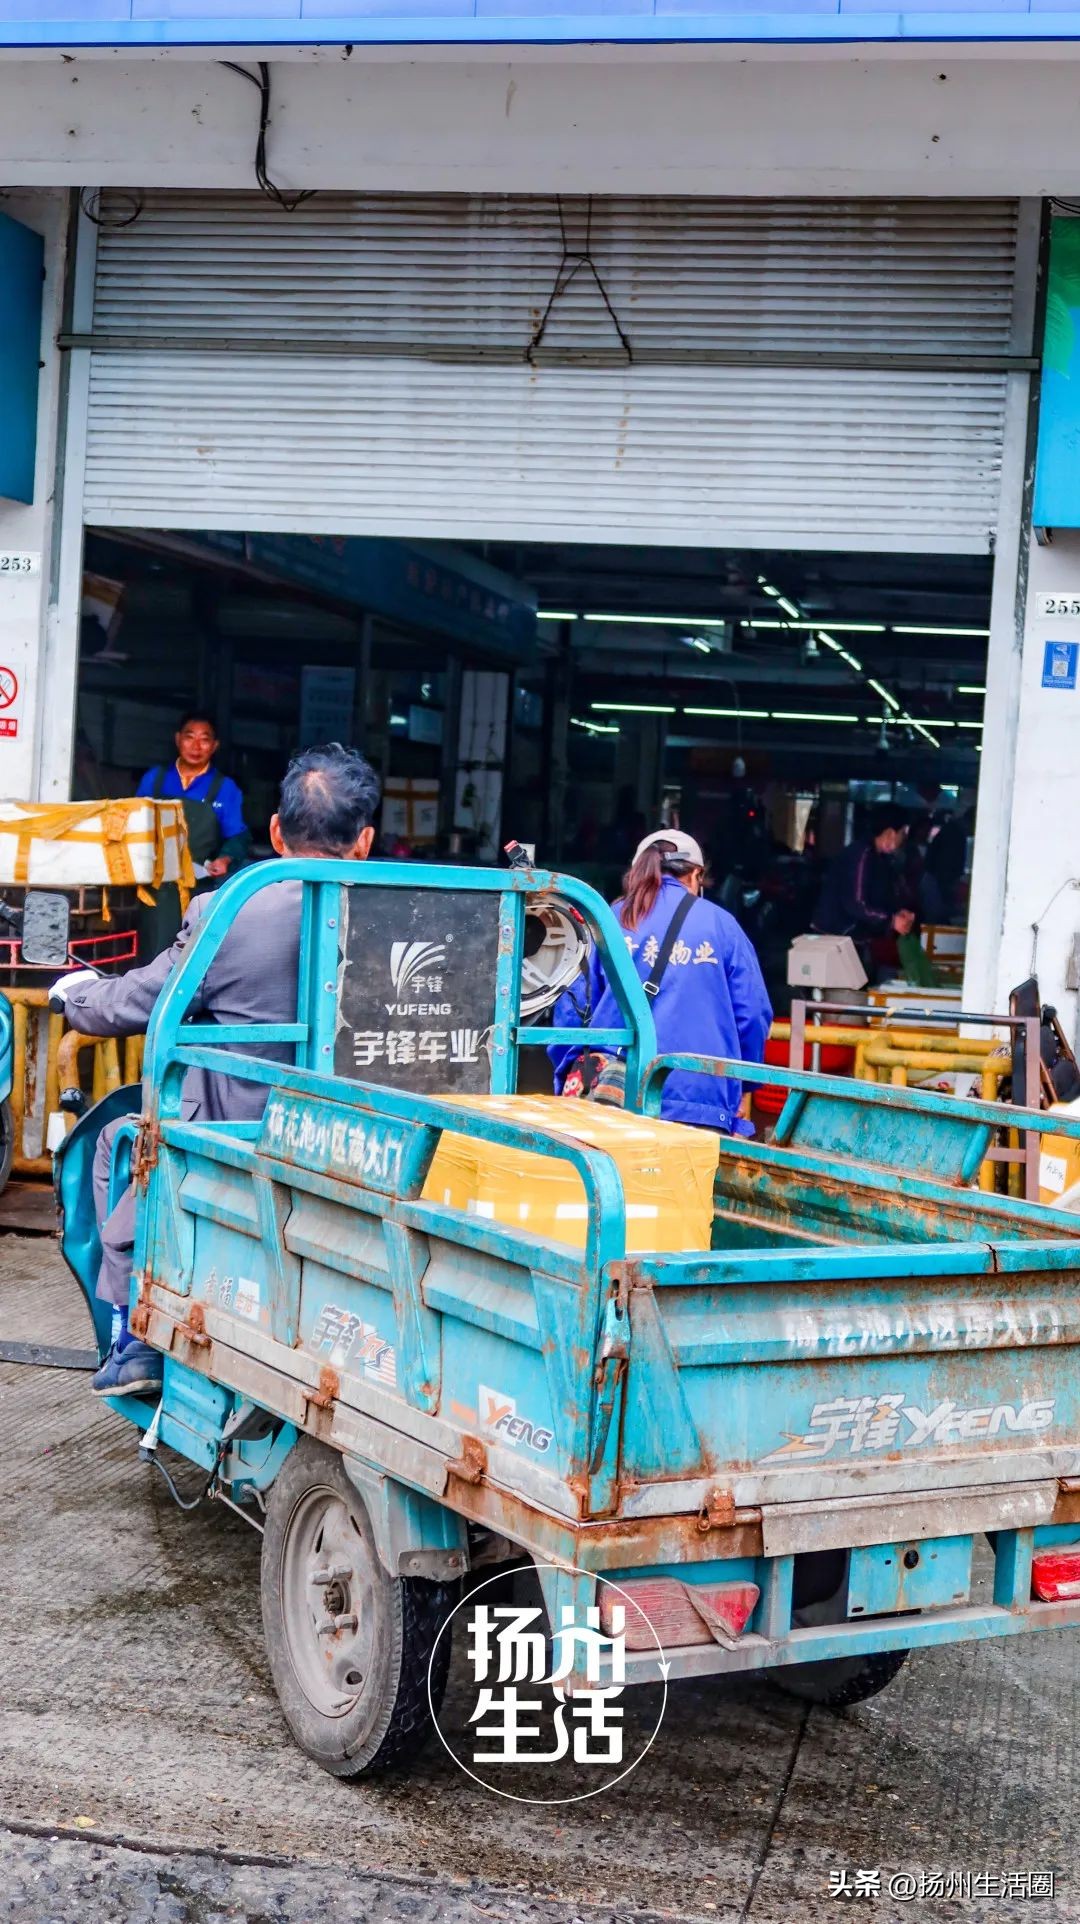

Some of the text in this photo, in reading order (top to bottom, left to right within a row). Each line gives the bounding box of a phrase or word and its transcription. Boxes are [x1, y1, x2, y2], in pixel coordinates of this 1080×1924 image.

[1, 557, 31, 570] 253
[1045, 599, 1080, 614] 255
[411, 976, 443, 993] 宇锋
[385, 1003, 452, 1016] YUFENG
[353, 1029, 479, 1066] 宇锋车业
[803, 1393, 906, 1456] 宇锋
